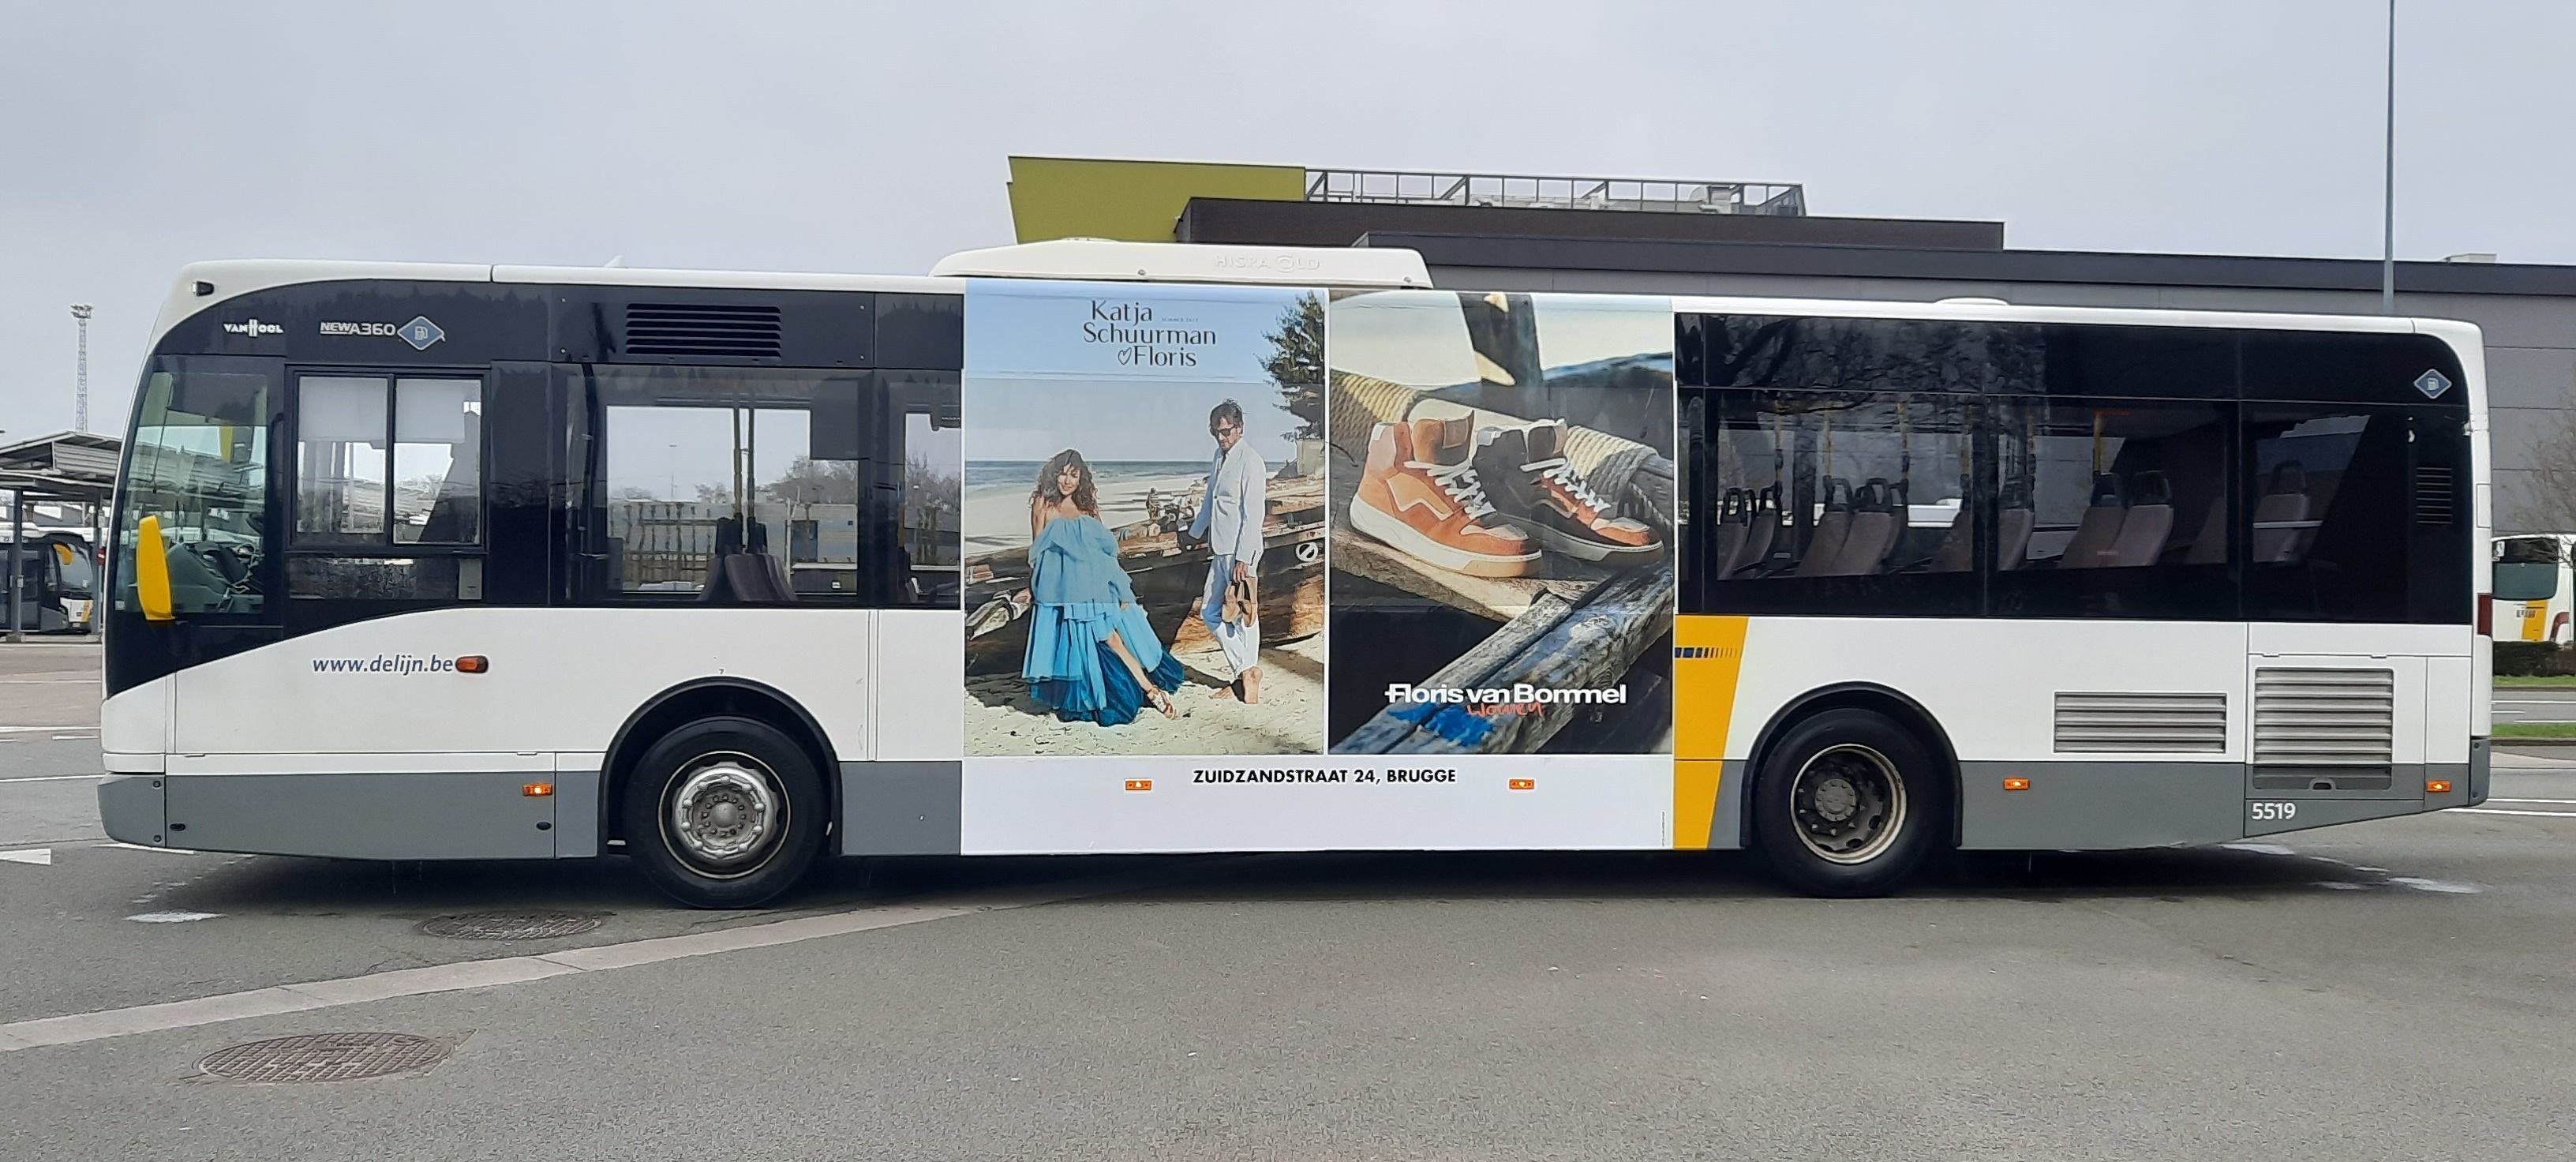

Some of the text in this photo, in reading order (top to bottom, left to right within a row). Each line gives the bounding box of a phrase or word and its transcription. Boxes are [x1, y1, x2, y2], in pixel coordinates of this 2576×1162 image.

[1091, 300, 1152, 326] Katja
[1083, 321, 1216, 345] Schuurman
[1134, 345, 1196, 367] Floris
[313, 654, 453, 676] www.delijn.be
[1385, 684, 1626, 704] Floris van Bommel
[1193, 770, 1456, 785] ZUIDZANDSTRAAT 24, BRUGGE
[2252, 802, 2296, 819] 5519
